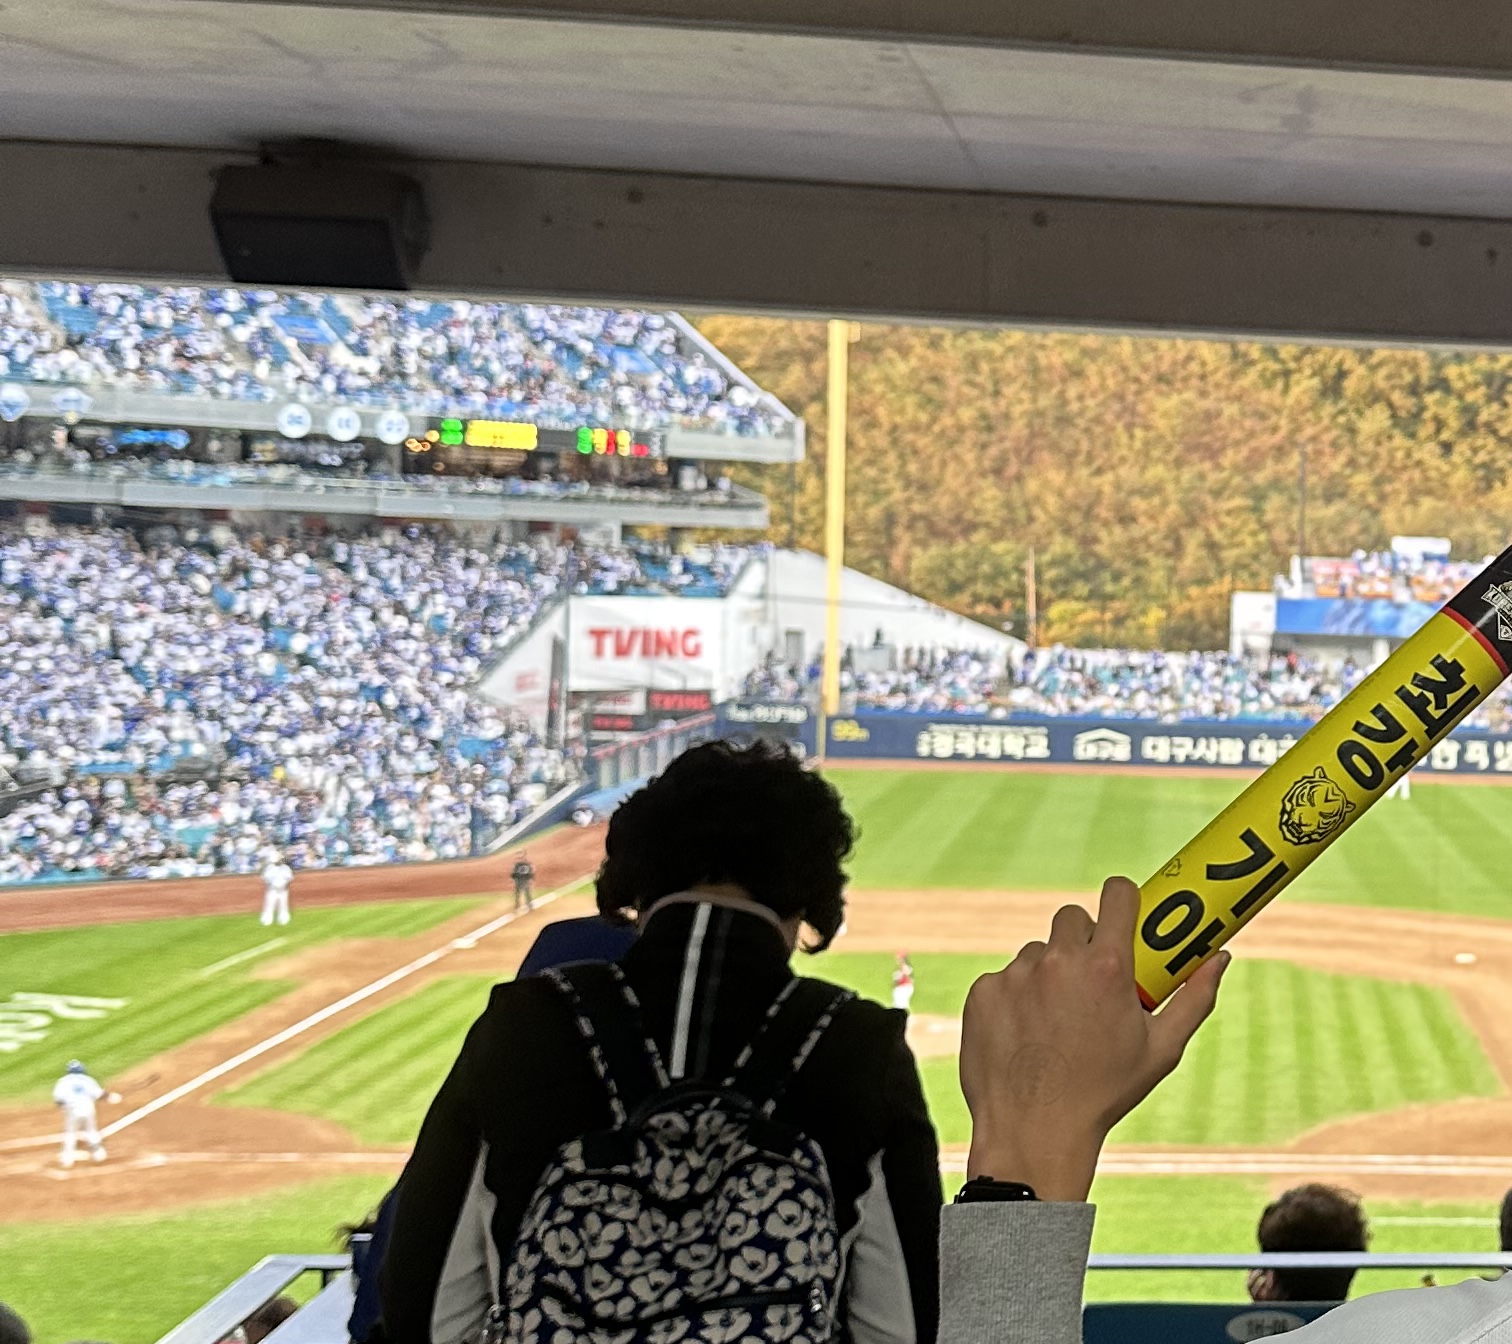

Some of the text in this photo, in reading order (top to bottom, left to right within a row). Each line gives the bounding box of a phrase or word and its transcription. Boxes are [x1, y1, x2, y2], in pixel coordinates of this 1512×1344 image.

[588, 627, 702, 659] TVING
[1337, 653, 1481, 791] 최강
[1140, 828, 1290, 977] 기아
